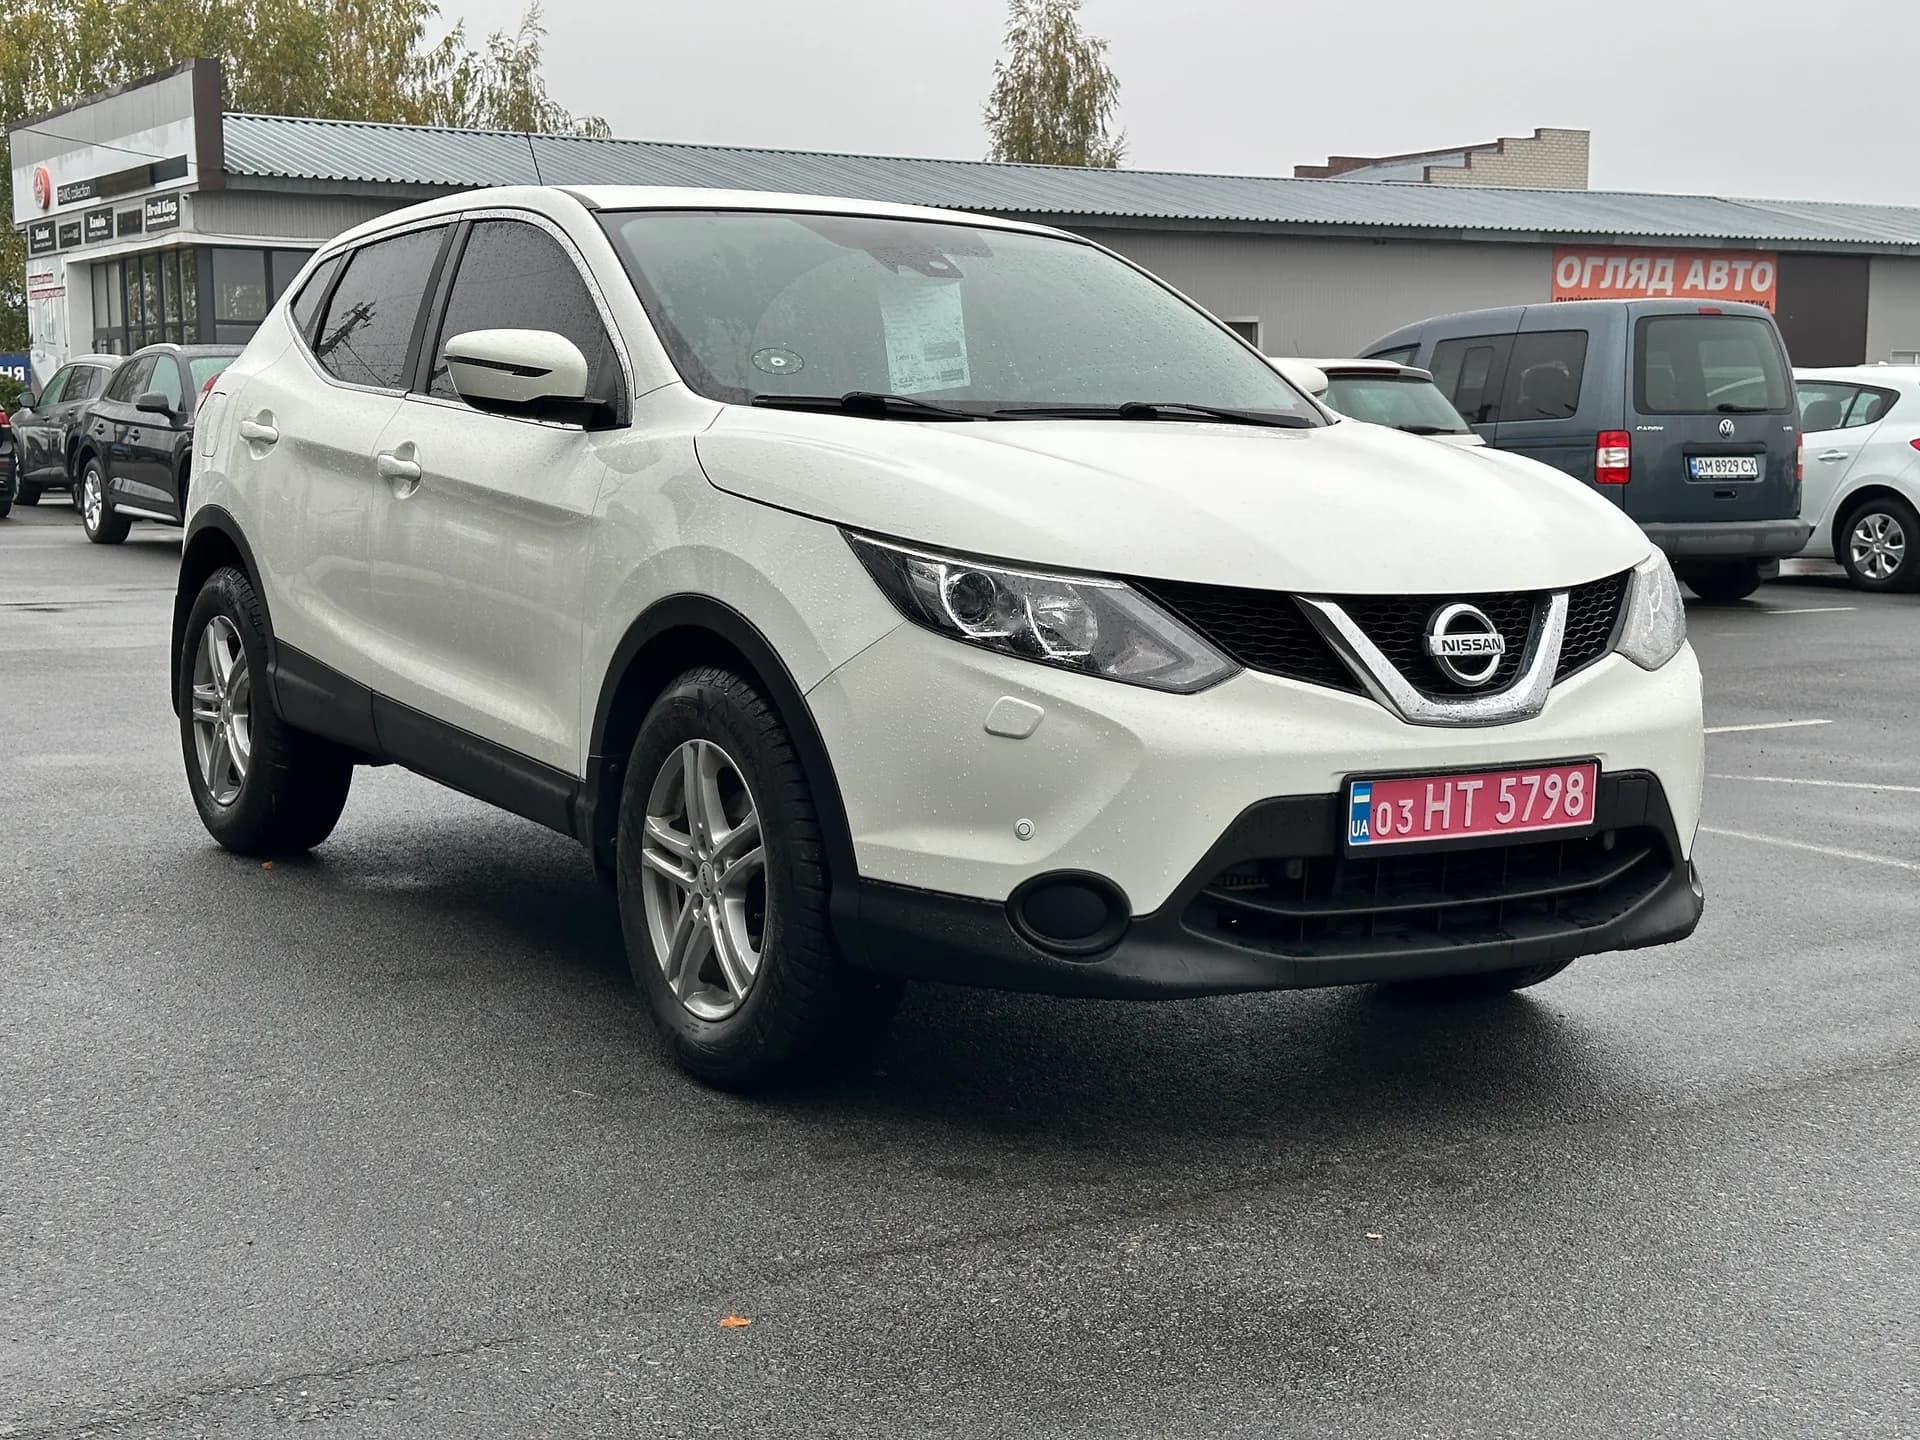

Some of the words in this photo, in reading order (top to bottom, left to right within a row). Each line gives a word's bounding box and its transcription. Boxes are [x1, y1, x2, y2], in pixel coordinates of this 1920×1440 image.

[1556, 255, 1675, 296] ОГЛЯД
[1683, 259, 1774, 292] АВТО
[1698, 460, 1713, 473] AM
[1715, 460, 1739, 473] 8929
[1741, 460, 1756, 473] CX
[1441, 638, 1501, 652] NISSAN
[1375, 799, 1414, 836] 03
[1423, 780, 1484, 831] HT
[1495, 771, 1585, 824] 5798
[1351, 819, 1369, 837] UA
